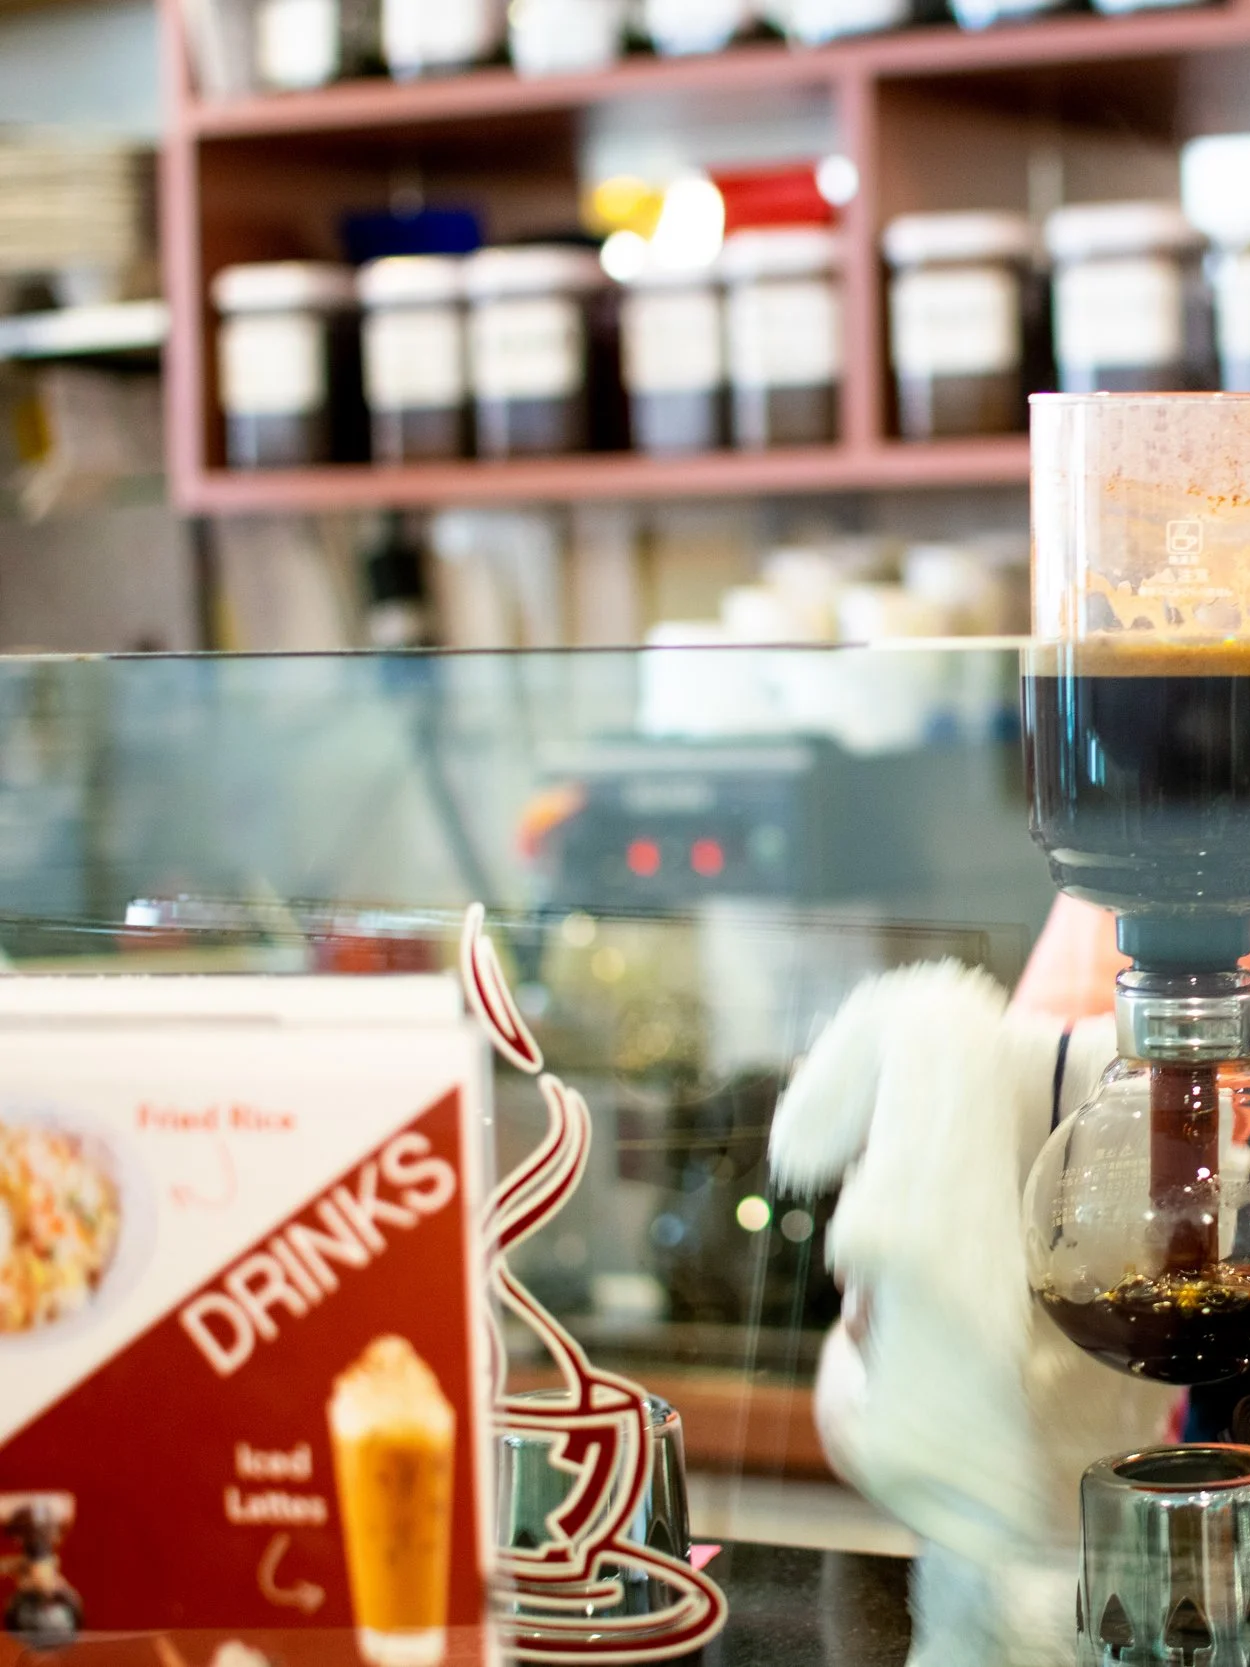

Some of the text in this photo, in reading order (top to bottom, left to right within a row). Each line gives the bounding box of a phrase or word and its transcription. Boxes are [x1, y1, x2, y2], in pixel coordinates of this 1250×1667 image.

[136, 1103, 296, 1132] Fried Rice
[178, 1131, 457, 1377] DRINKS
[235, 1443, 311, 1482] Iced
[225, 1486, 327, 1525] Lattes
